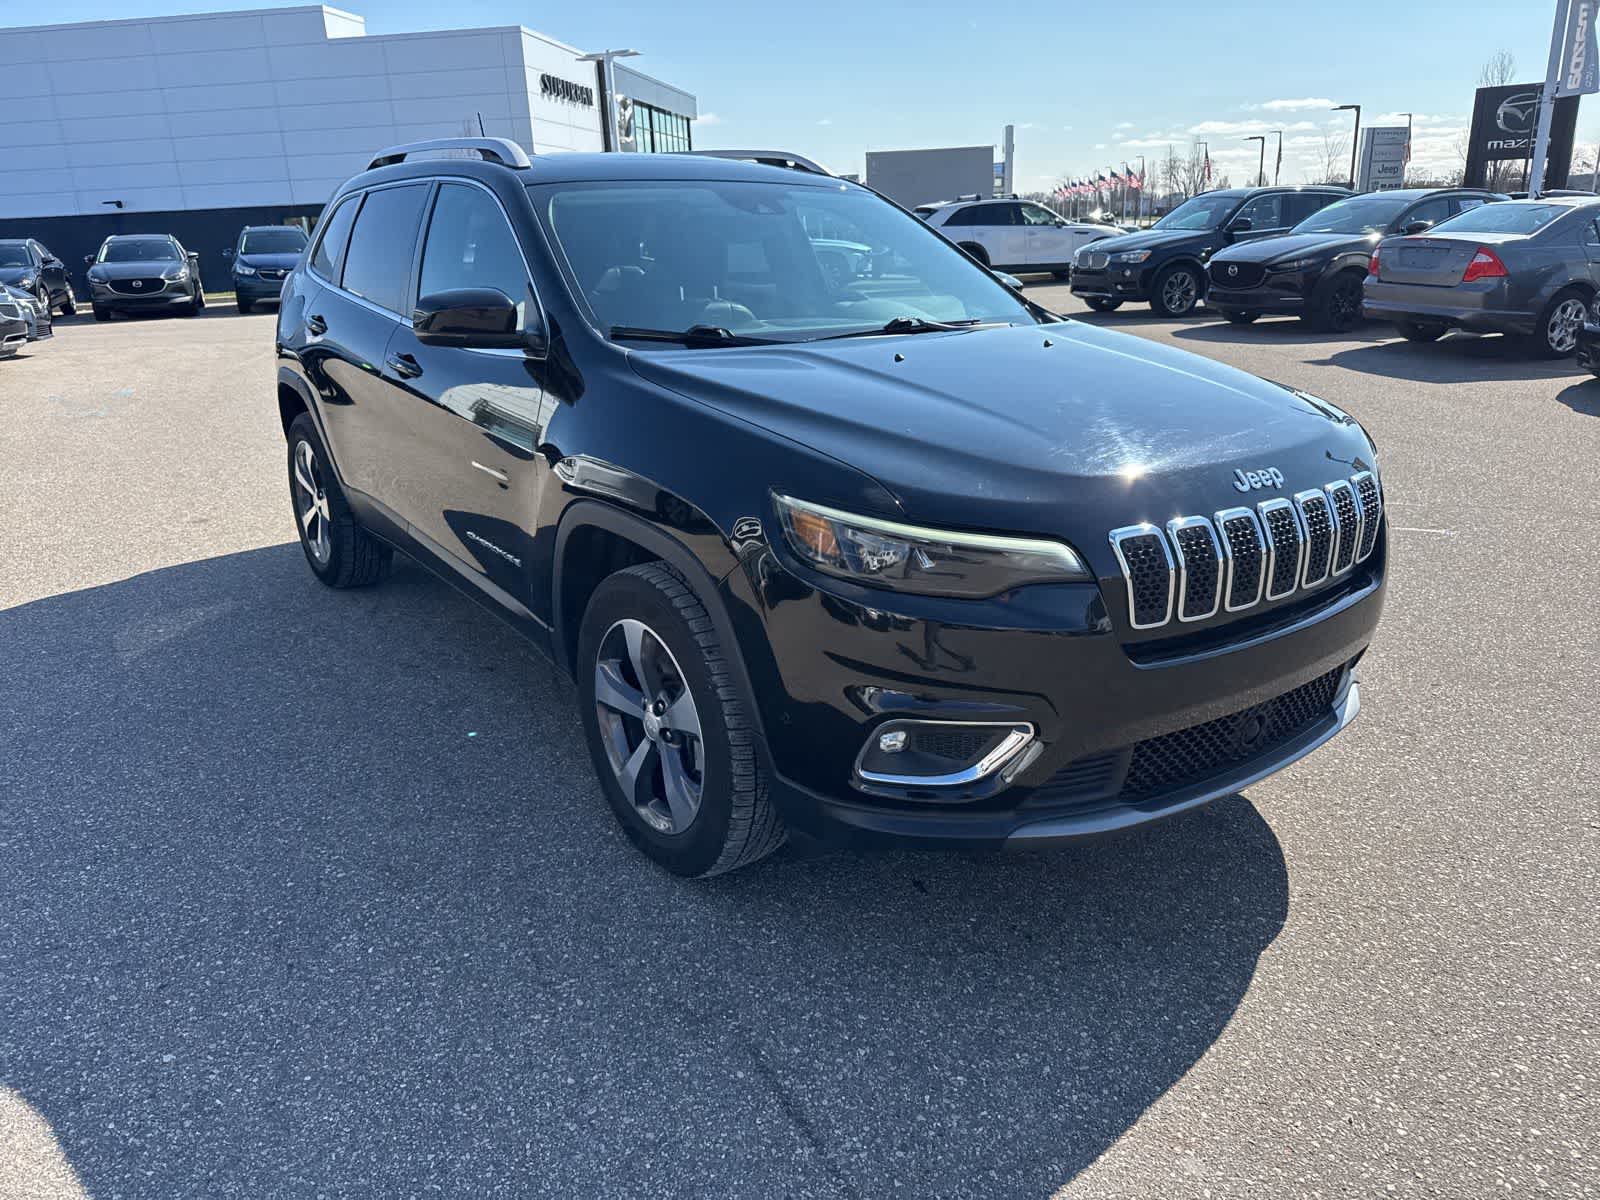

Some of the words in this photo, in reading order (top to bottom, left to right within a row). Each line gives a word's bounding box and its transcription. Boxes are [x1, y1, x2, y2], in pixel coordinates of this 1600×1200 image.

[541, 73, 593, 105] SUBURBAN
[1377, 164, 1399, 176] Jeep
[1232, 466, 1285, 493] Jeep
